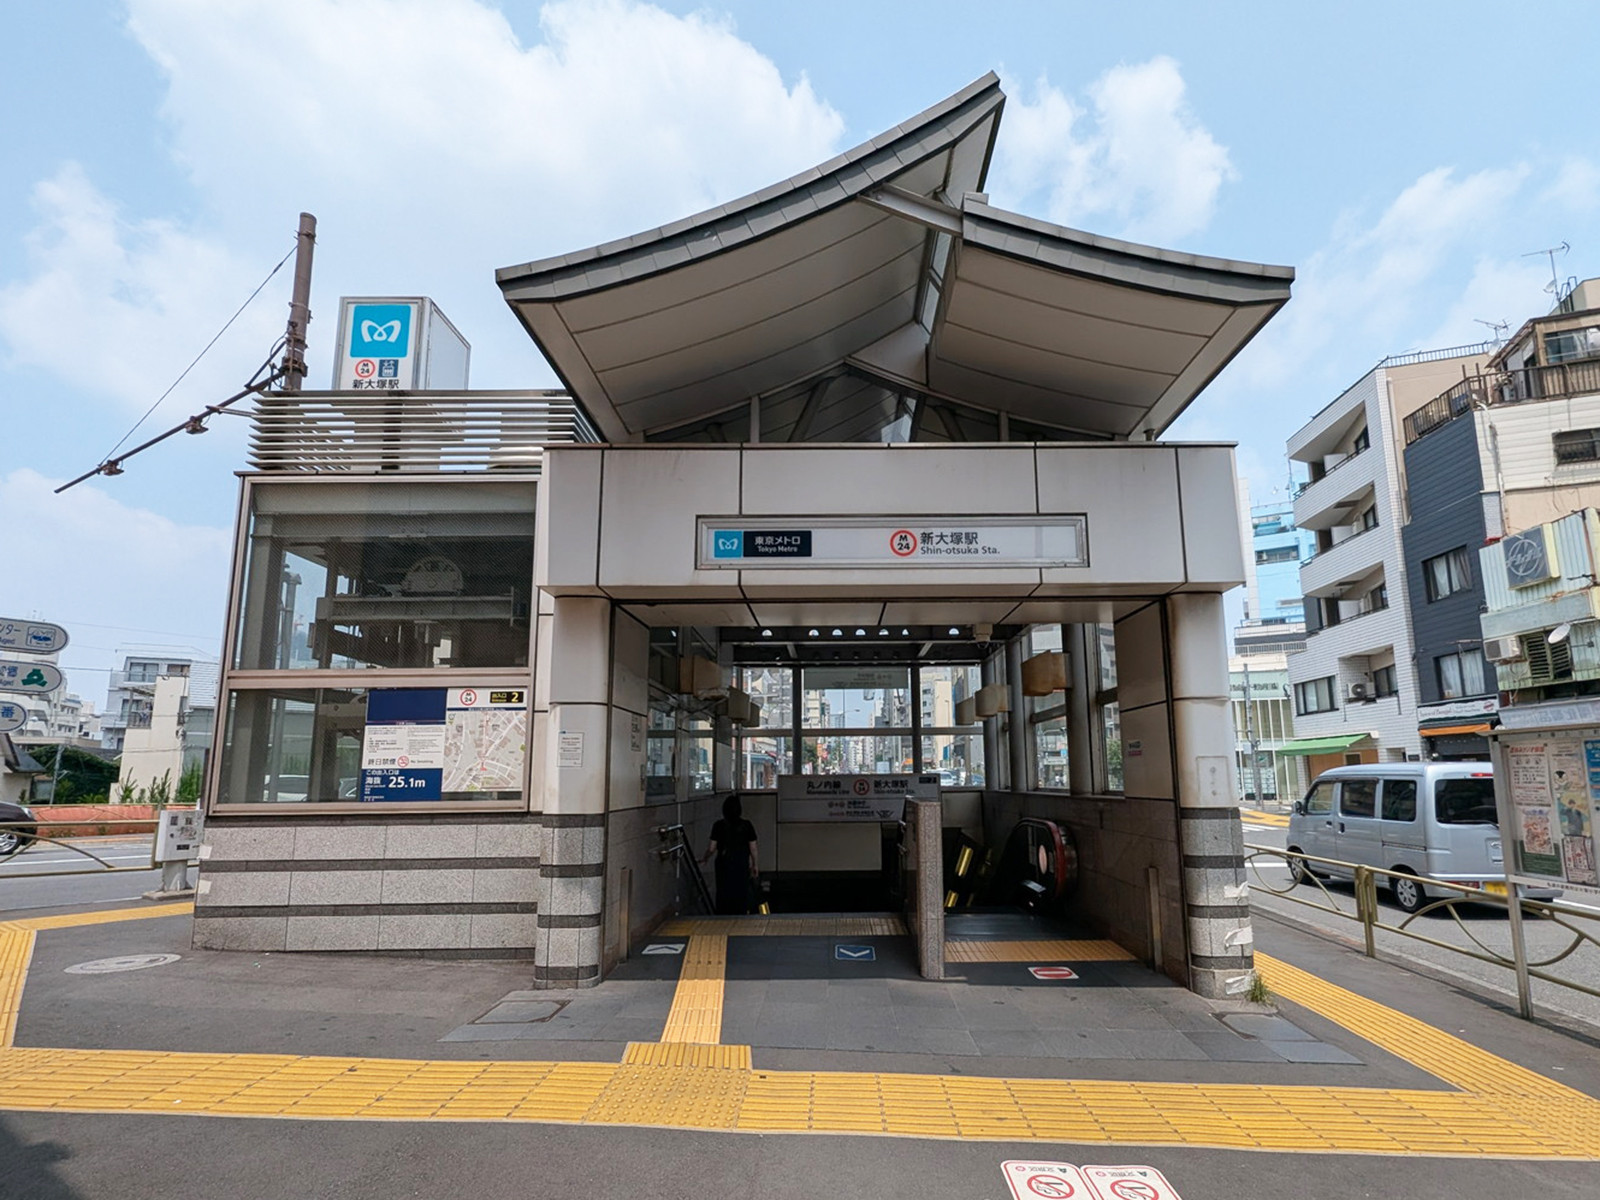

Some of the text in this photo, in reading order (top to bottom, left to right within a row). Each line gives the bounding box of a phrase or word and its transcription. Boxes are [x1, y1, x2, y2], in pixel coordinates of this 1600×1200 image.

[352, 379, 400, 390] 新大塚駅
[754, 536, 801, 545] 東京メトロ
[899, 534, 908, 542] M
[920, 532, 979, 545] 新大塚駅
[758, 546, 777, 554] Tokyo
[897, 542, 910, 550] 24
[921, 546, 1000, 554] Shin-otsuka Sta.
[511, 692, 519, 702] 2
[365, 776, 426, 788] 海抜 25.1m
